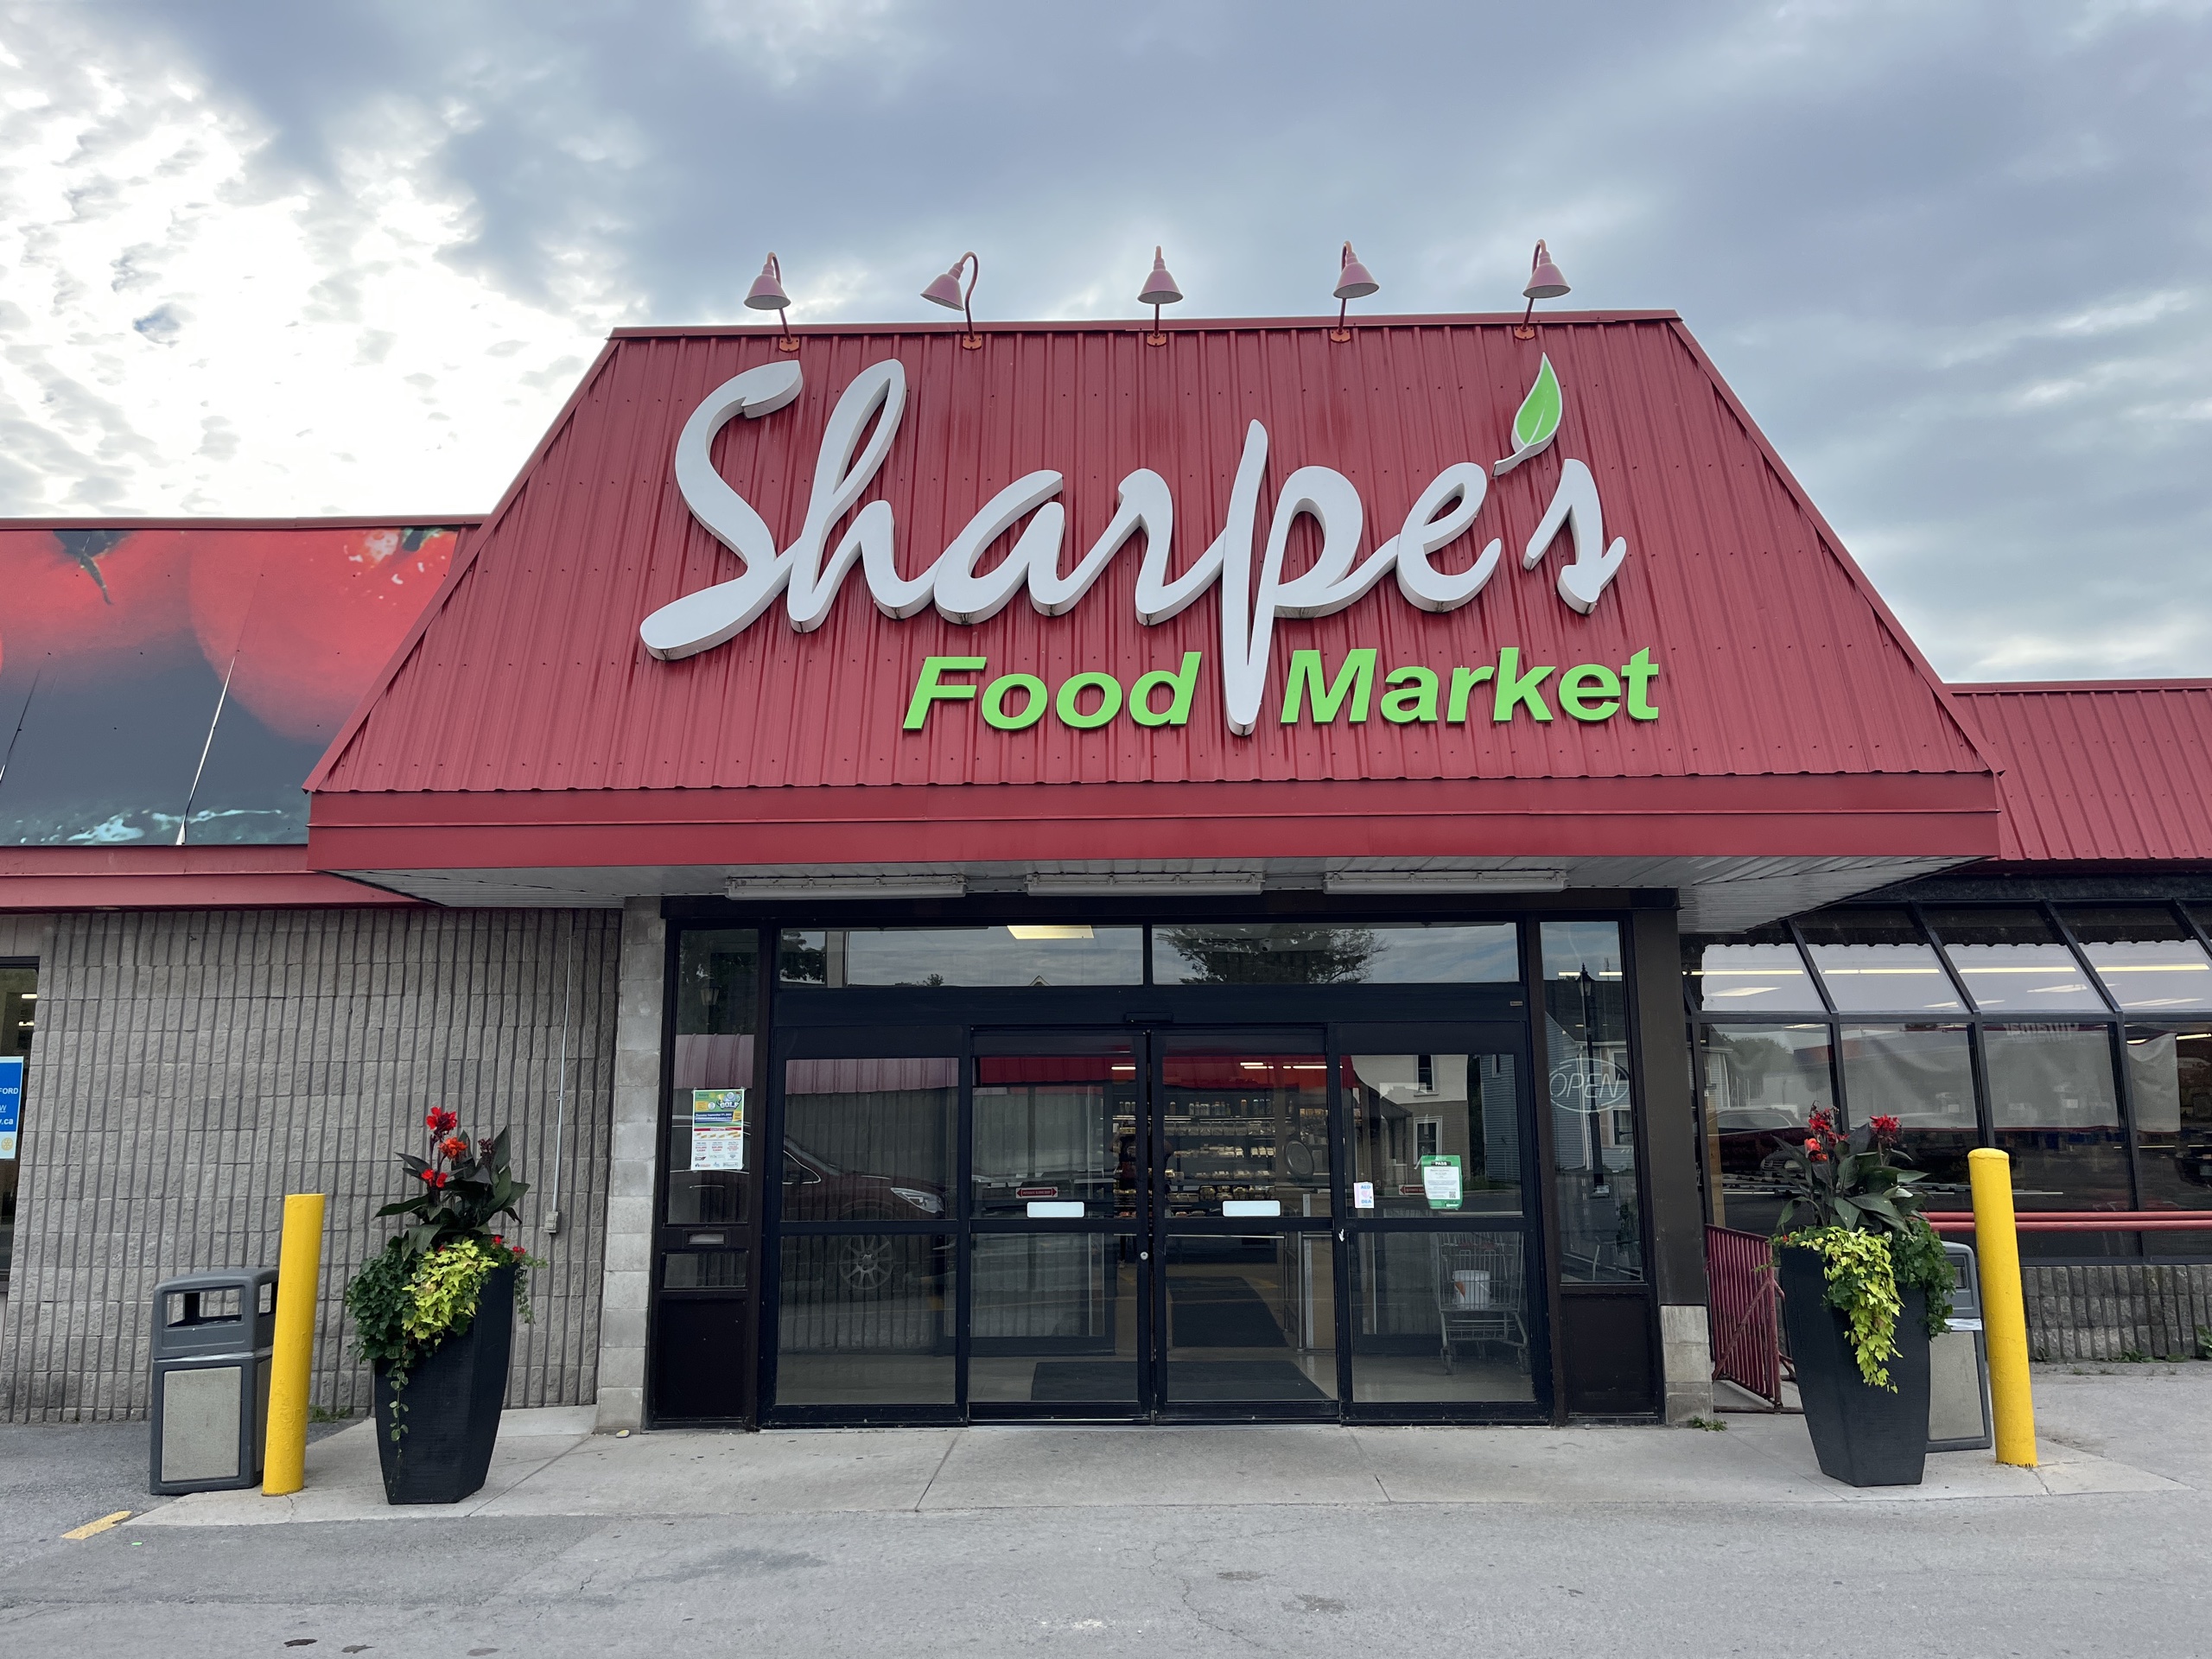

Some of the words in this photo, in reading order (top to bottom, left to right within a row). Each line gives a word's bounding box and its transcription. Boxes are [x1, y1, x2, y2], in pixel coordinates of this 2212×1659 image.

[640, 352, 1628, 736] Sharpe's
[904, 650, 1202, 731] Food
[1280, 647, 1660, 725] Market
[1548, 1072, 1621, 1098] OPEN
